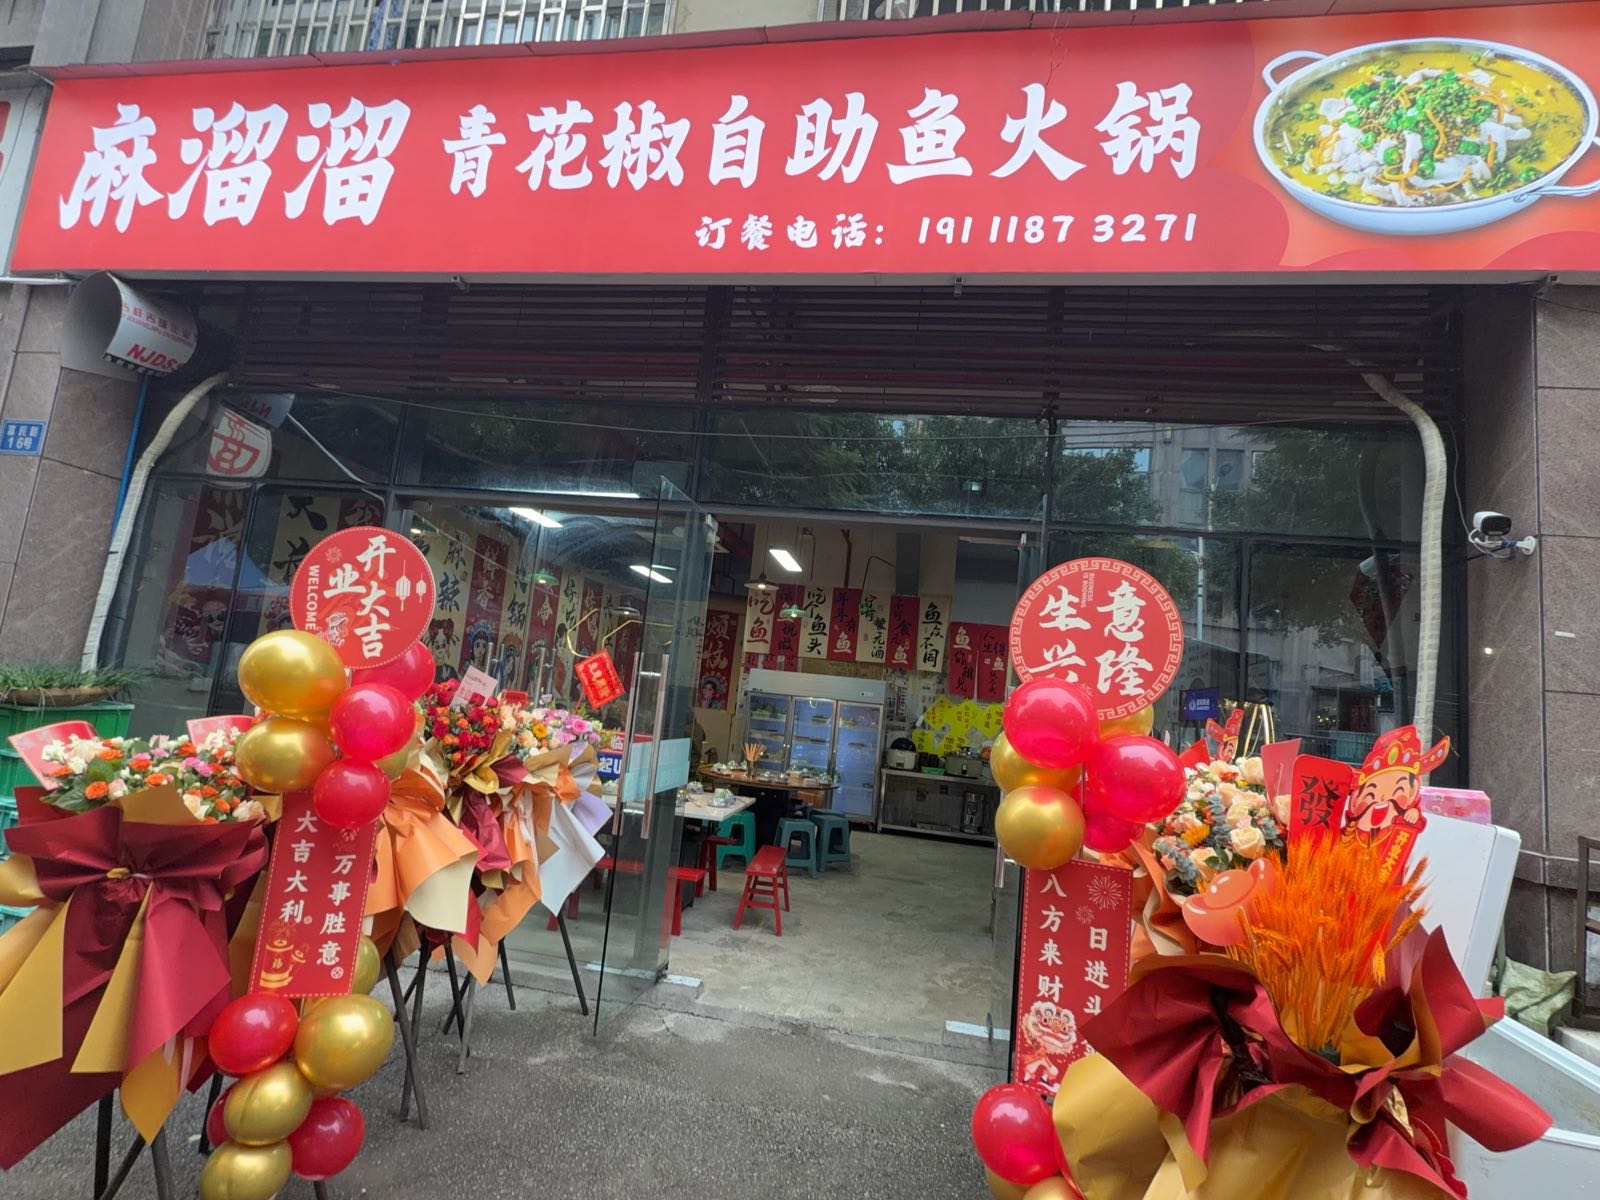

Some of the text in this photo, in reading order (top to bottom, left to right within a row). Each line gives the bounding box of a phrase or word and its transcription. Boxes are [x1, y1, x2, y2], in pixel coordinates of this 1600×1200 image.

[59, 97, 411, 233] 麻溜溜
[442, 80, 1201, 198] 青花椒自助鱼火锅
[918, 215, 973, 244] 191
[989, 214, 1075, 244] 1187
[1092, 212, 1197, 243] 3271
[305, 564, 320, 631] WELCOME
[323, 535, 396, 658] 开业大吉
[746, 590, 775, 645] 吃鱼
[803, 587, 828, 656] 吃个鱼头
[833, 592, 857, 655] 年年有鱼
[919, 602, 944, 668] 鱼众不同
[1300, 774, 1342, 830] 發
[279, 810, 318, 925] 大吉大利
[316, 853, 358, 966] 万事胜意
[1037, 873, 1068, 1003] 八方来财
[1083, 926, 1111, 1056] 日进斗
